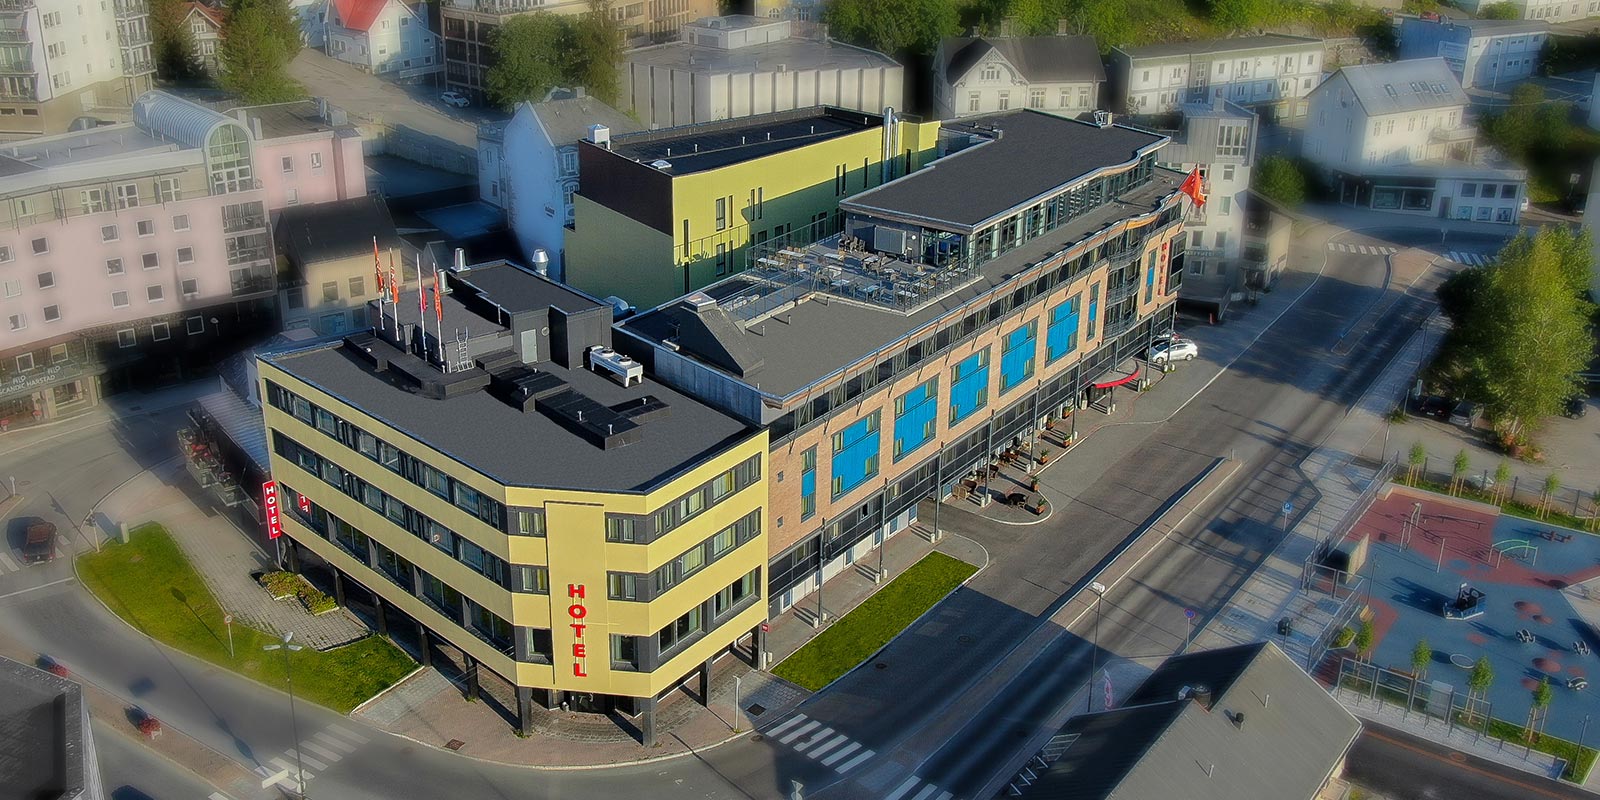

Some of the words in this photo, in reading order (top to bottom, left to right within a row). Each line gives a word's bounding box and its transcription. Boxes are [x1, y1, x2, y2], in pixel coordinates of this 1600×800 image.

[1157, 242, 1168, 296] HOTEL
[266, 486, 279, 535] HOTEL
[568, 584, 587, 677] HOTEL
